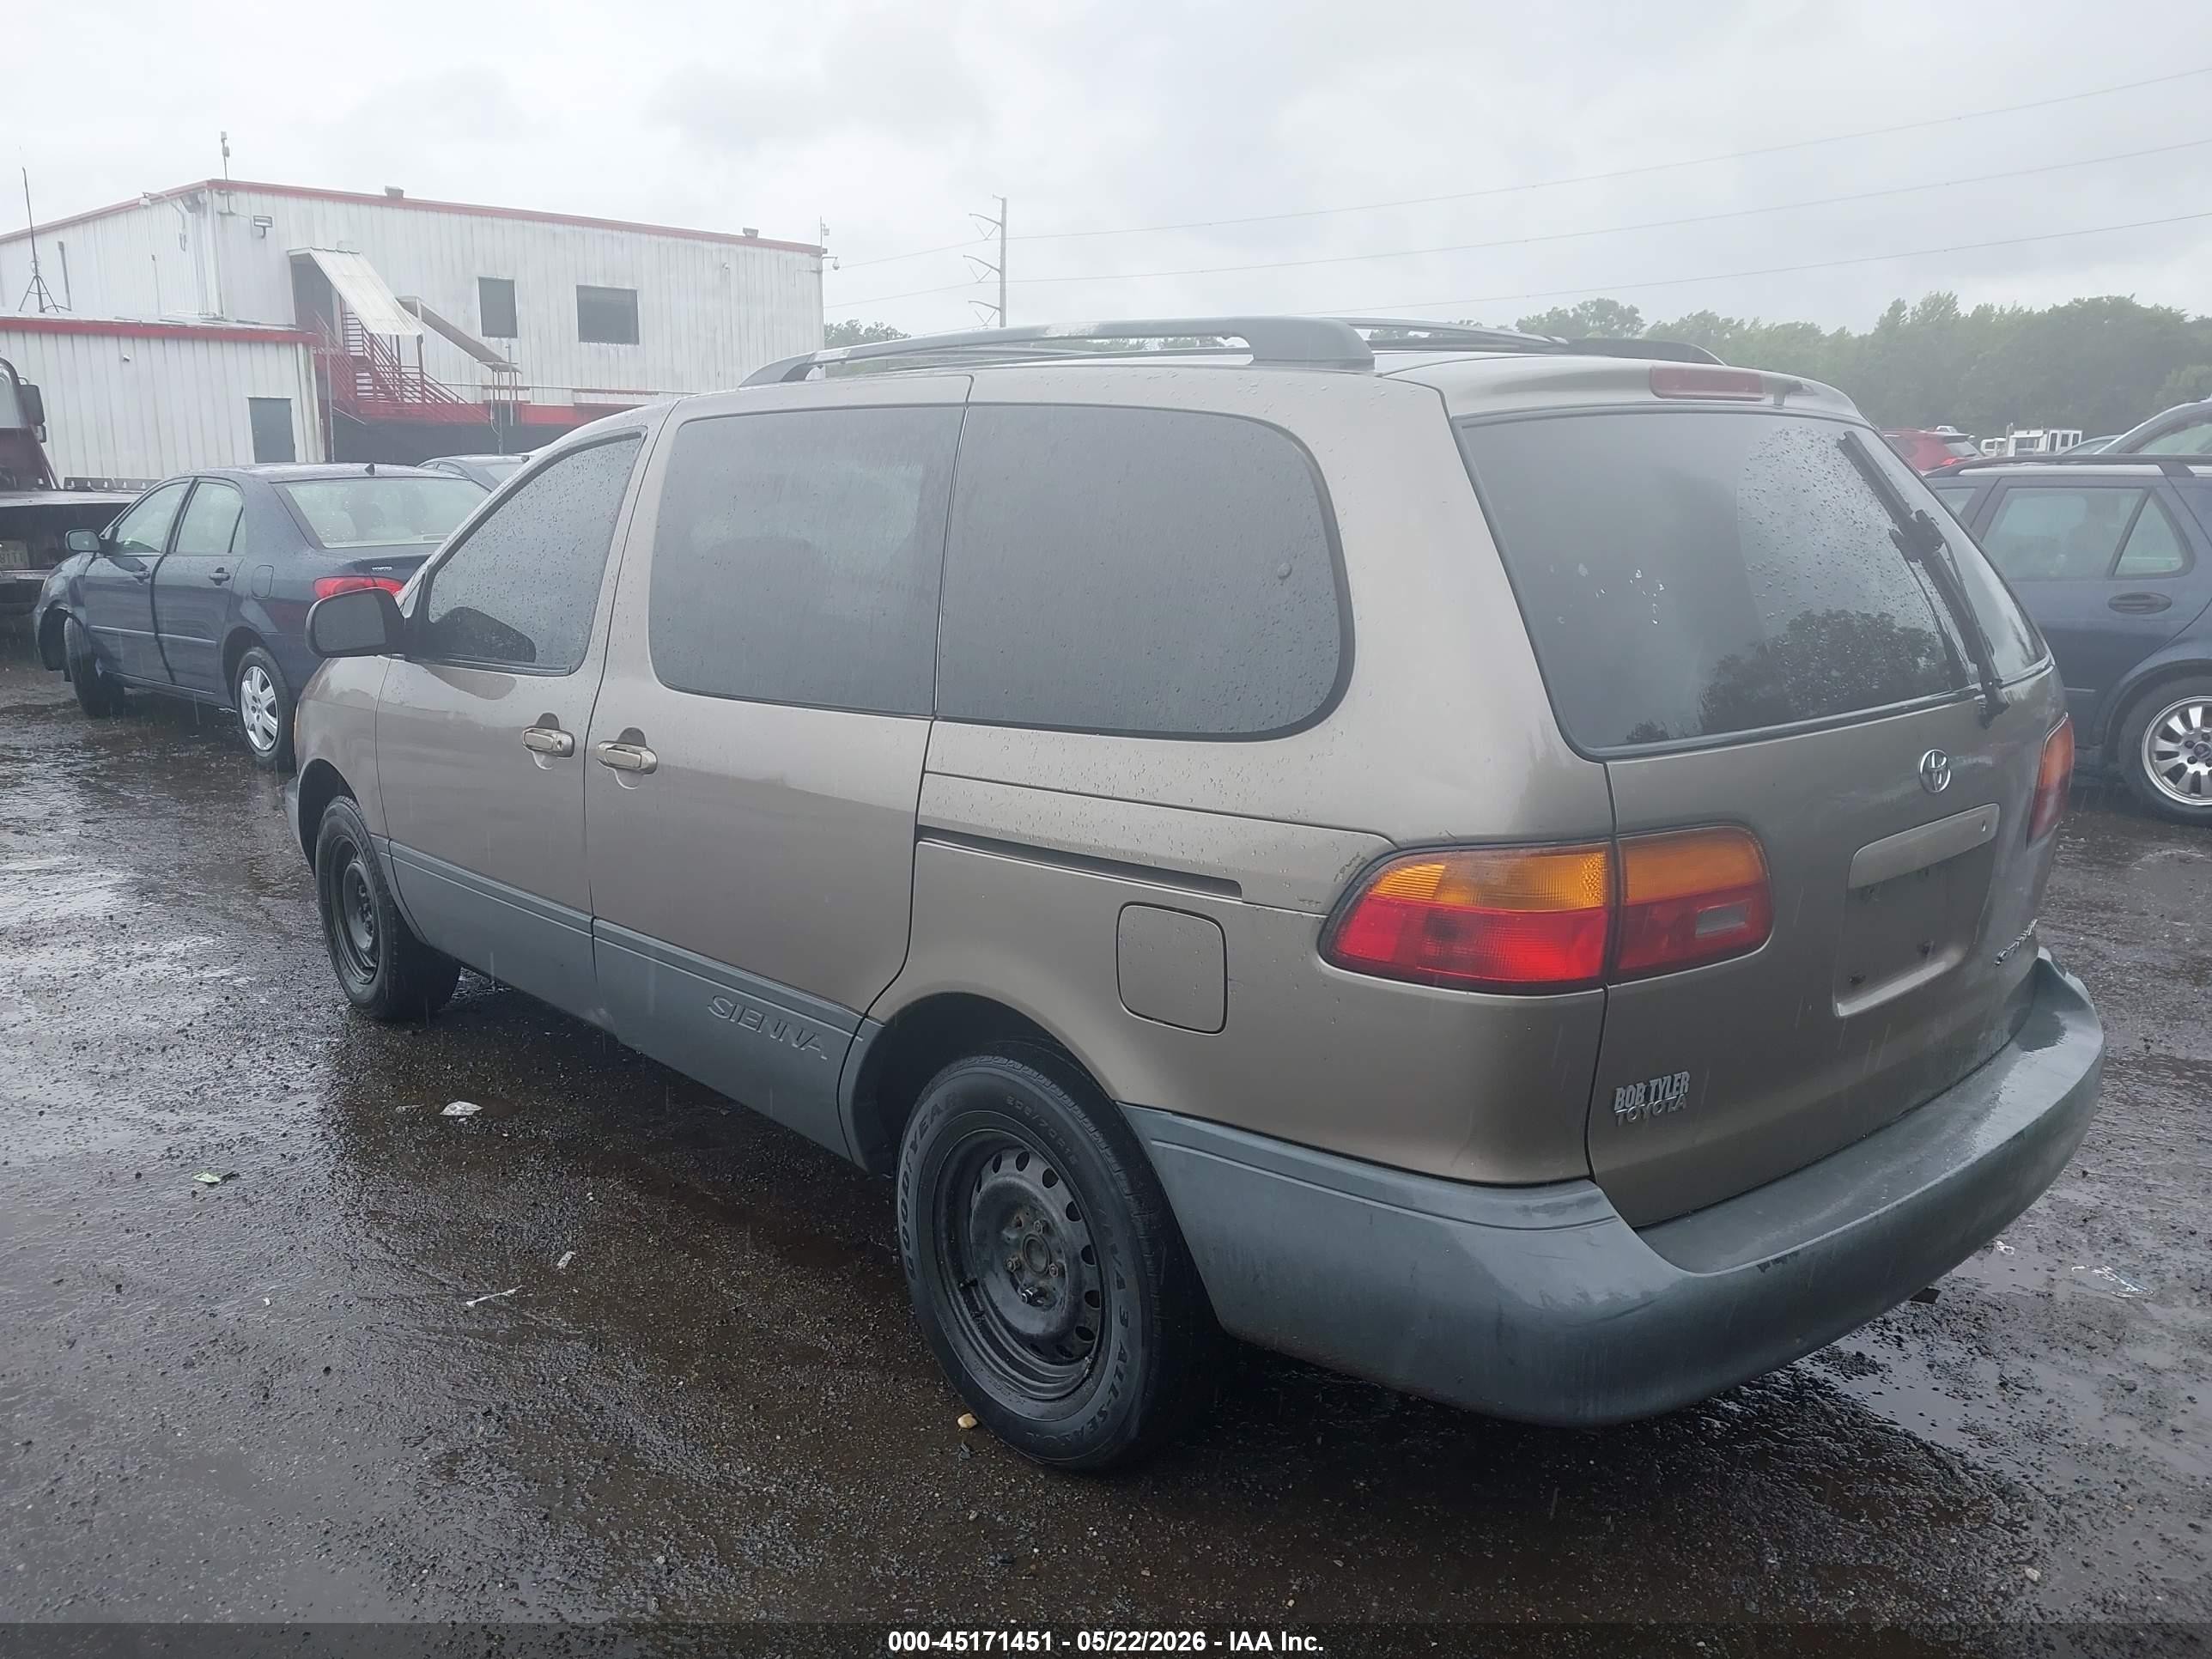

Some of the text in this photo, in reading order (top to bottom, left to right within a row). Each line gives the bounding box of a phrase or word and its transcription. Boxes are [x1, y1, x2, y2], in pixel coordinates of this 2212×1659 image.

[708, 994, 828, 1060] SIENNA
[1614, 1071, 1691, 1111] BOB TYLER
[1614, 1093, 1688, 1127] TOYOTA
[900, 1091, 959, 1279] GOODYEAR
[1118, 1304, 1130, 1328] 3
